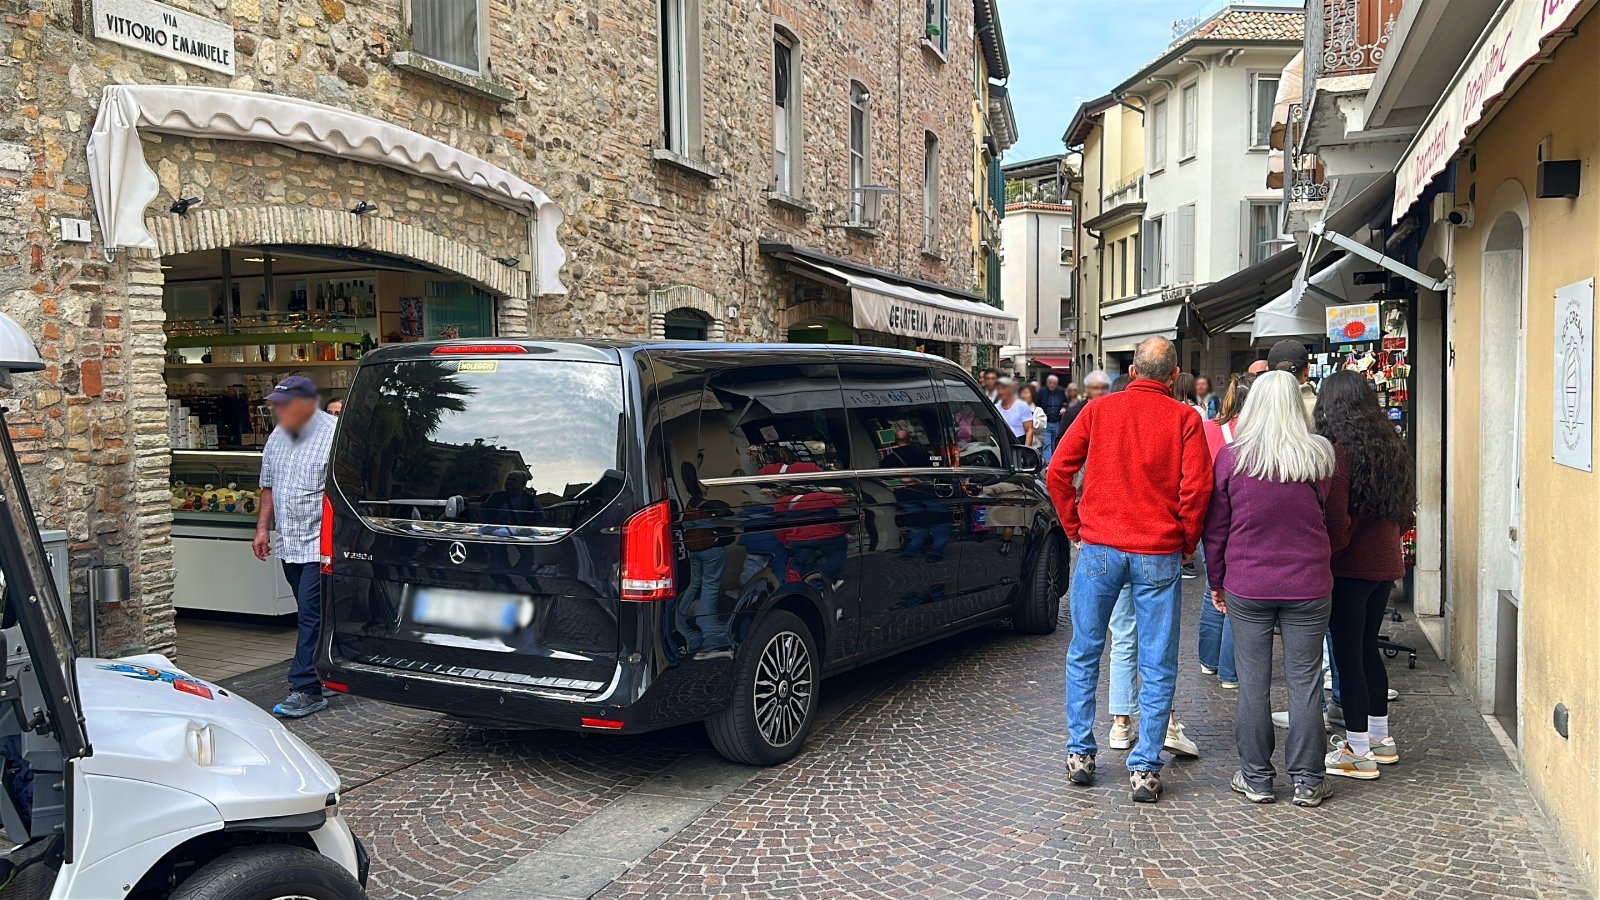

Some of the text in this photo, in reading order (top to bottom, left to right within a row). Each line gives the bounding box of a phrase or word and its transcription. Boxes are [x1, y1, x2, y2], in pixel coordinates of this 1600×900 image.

[163, 13, 178, 28] VIA
[106, 13, 229, 65] VITTORIO EMANUELE
[889, 304, 928, 333] GELATERIA
[1569, 310, 1584, 345] CREAM
[459, 362, 494, 370] NOLEGGIO
